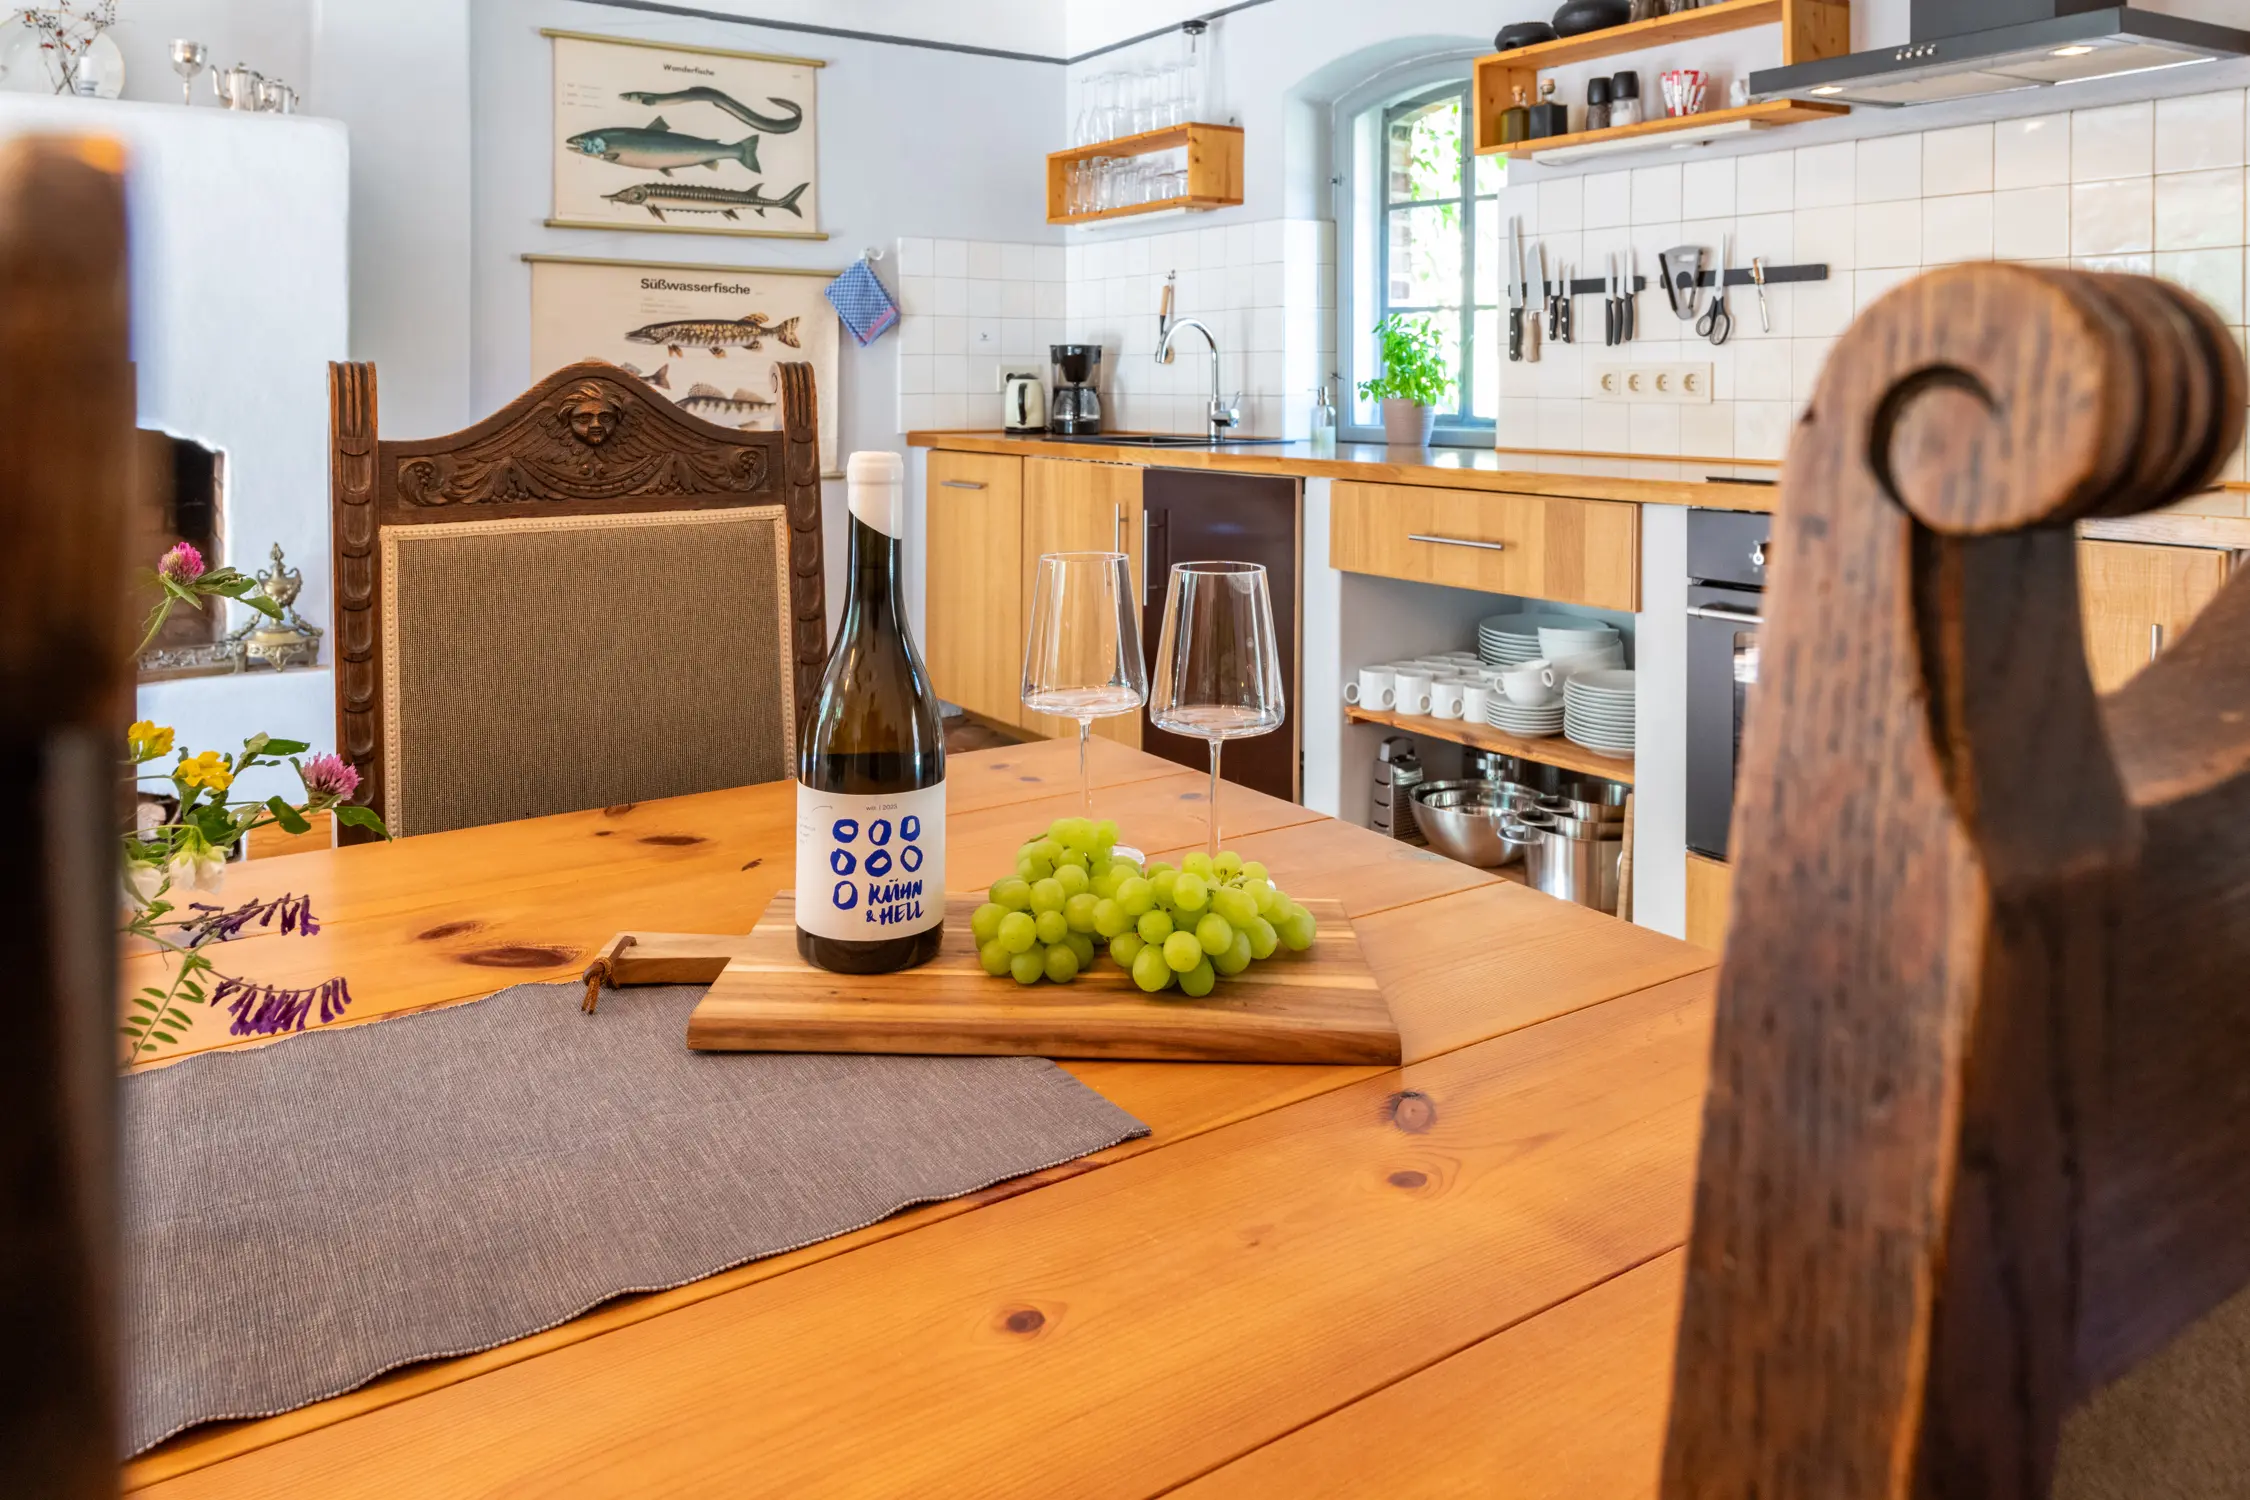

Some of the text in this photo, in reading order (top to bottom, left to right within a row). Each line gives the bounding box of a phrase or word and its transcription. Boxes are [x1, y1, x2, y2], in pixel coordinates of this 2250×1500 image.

[640, 278, 751, 295] Süßwasserfische
[866, 900, 924, 925] & HELL
